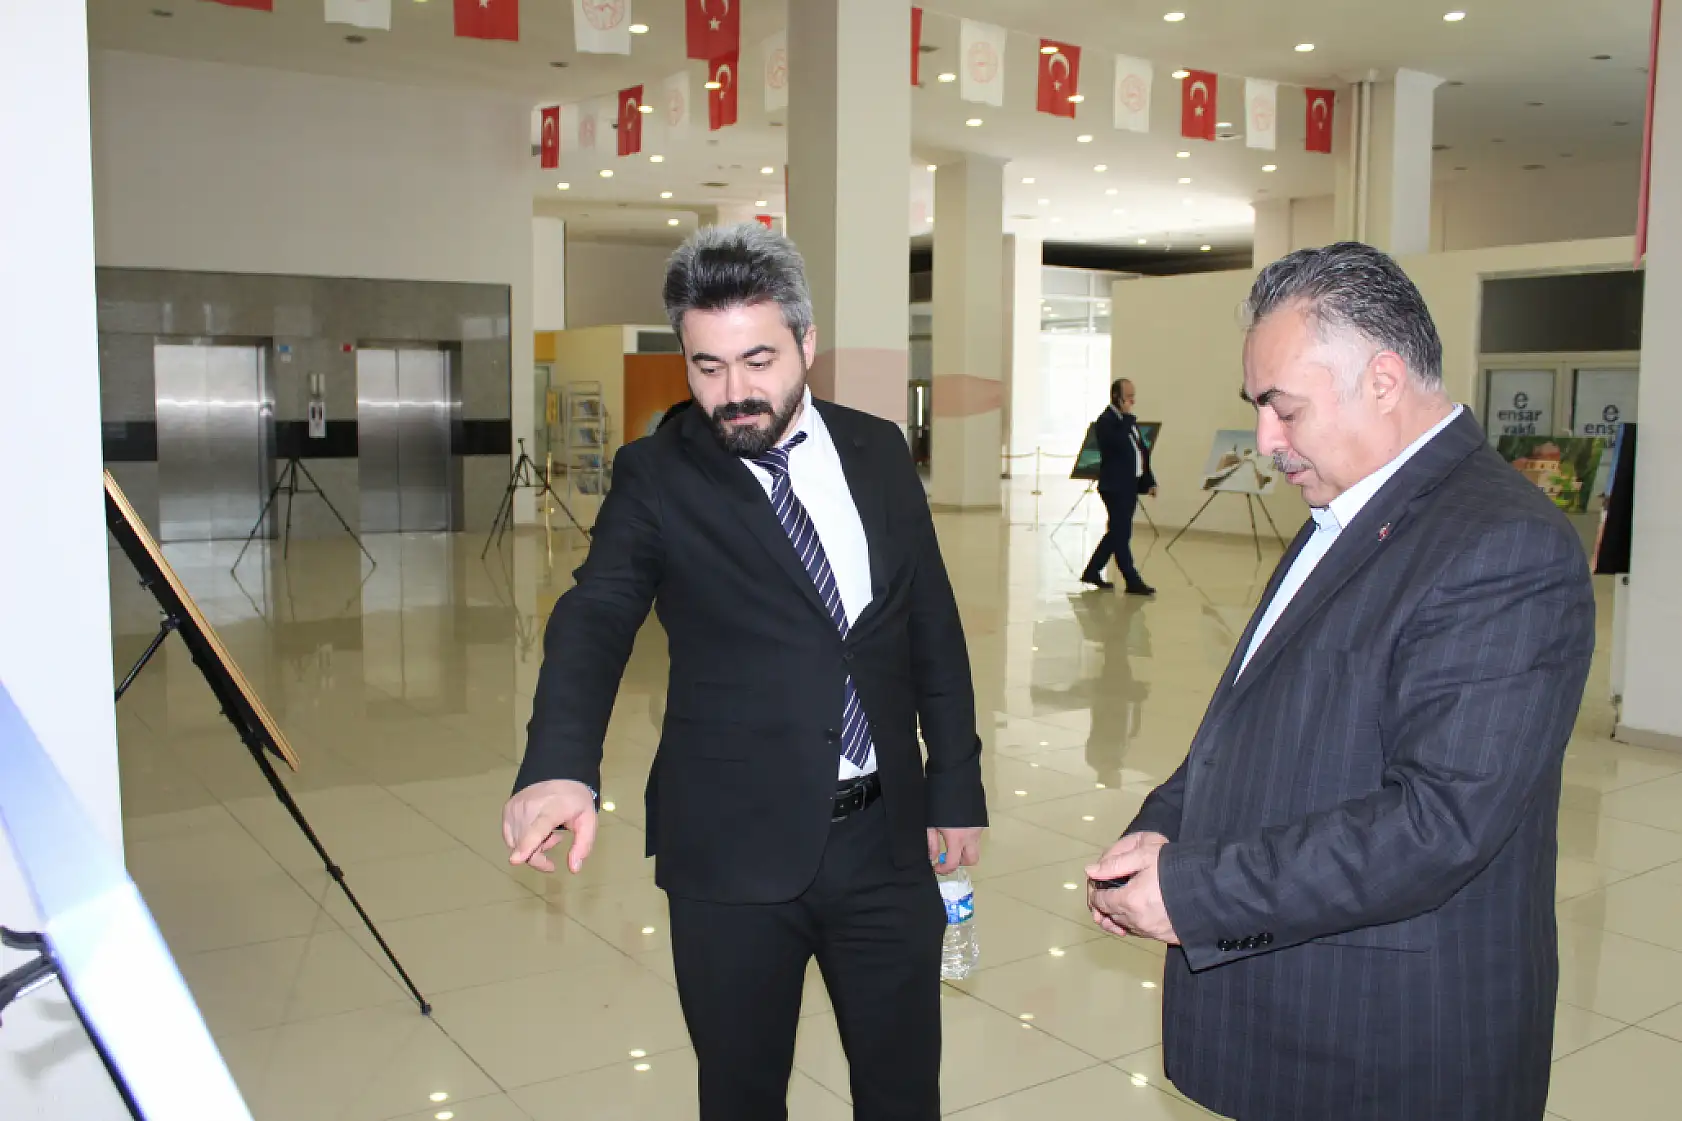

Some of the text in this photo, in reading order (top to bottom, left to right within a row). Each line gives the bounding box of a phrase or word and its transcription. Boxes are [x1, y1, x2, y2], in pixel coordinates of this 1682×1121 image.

[1513, 391, 1529, 409] e
[1497, 409, 1543, 421] ensar
[1602, 404, 1620, 422] e
[1583, 423, 1615, 435] ens
